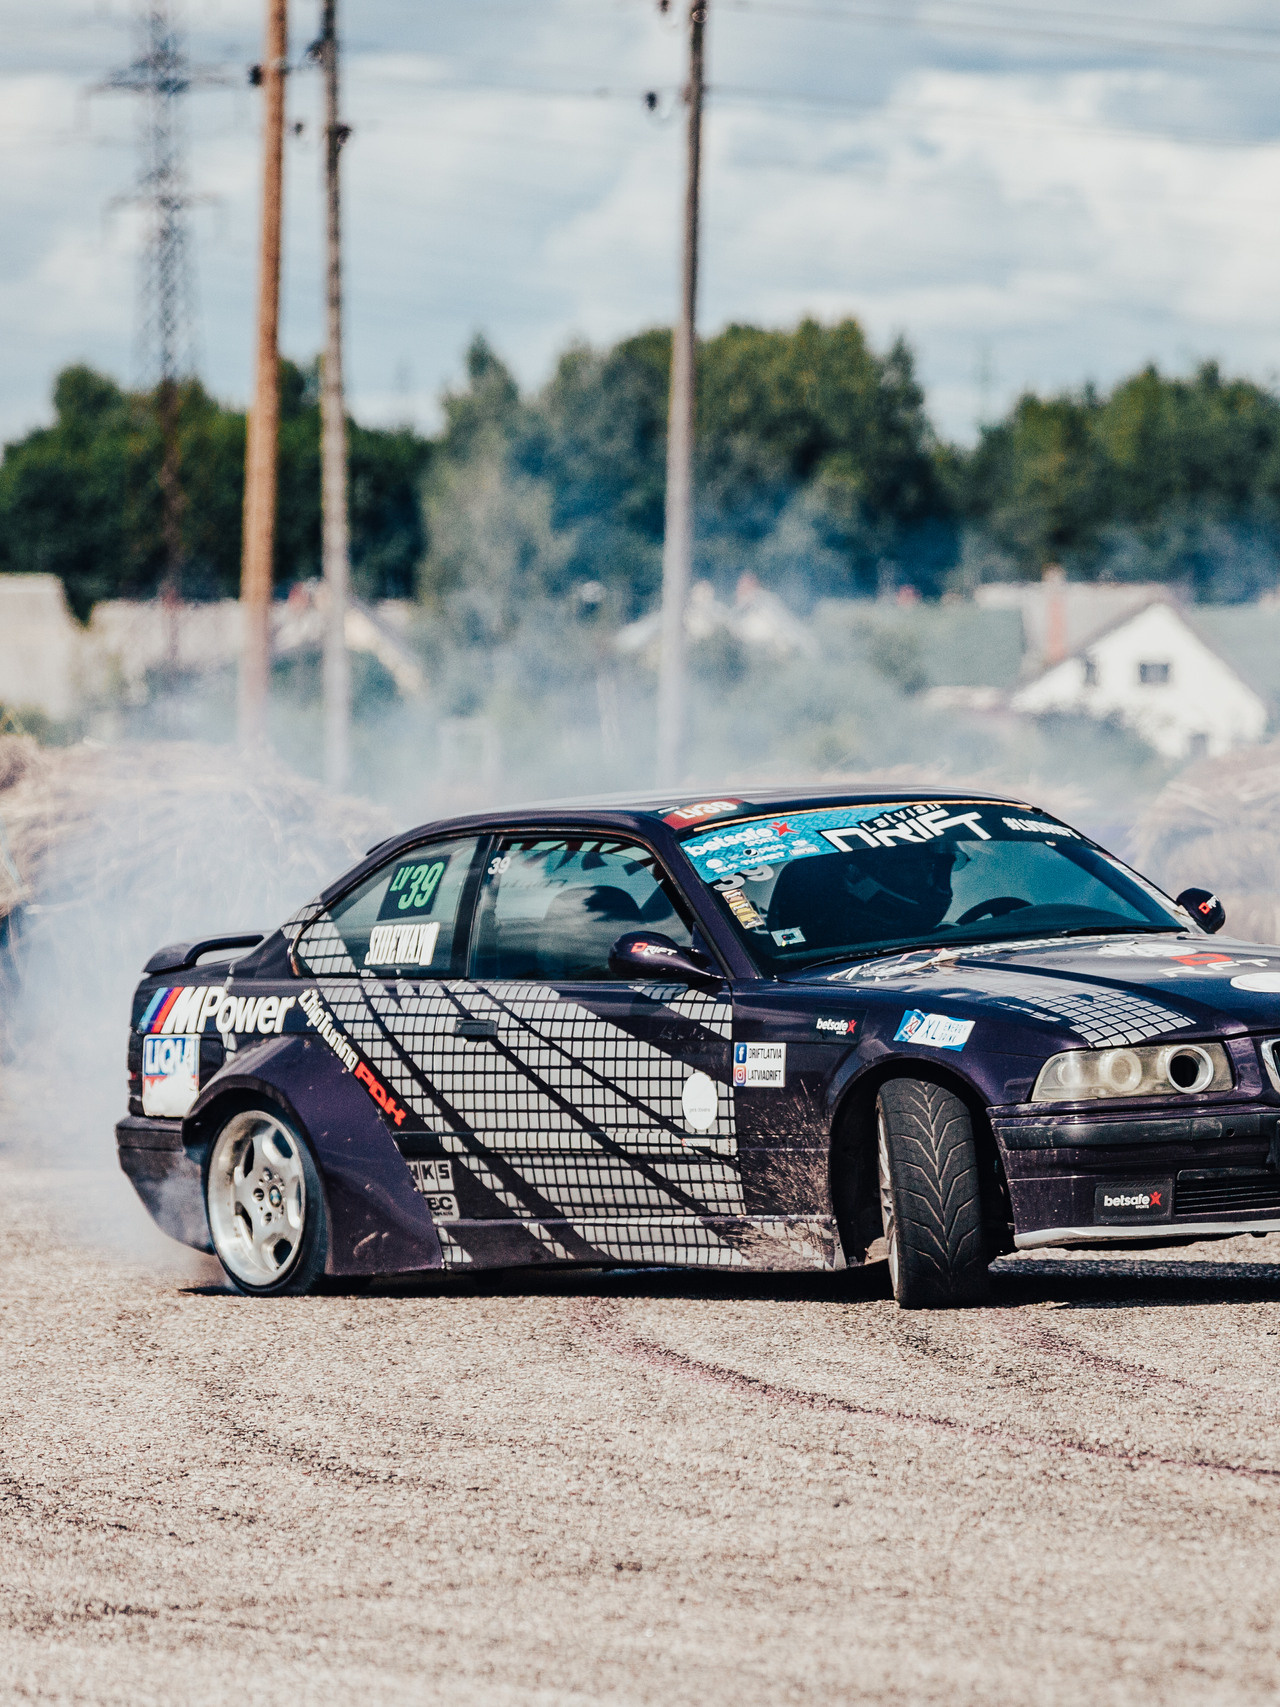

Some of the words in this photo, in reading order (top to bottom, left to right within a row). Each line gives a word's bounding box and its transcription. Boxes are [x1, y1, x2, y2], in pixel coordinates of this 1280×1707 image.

[860, 803, 941, 833] Latvian
[684, 827, 773, 857] betsafe
[487, 857, 511, 875] 39
[398, 862, 445, 910] 39
[631, 942, 677, 956] DRIFT
[816, 1018, 848, 1031] betsafe
[748, 1048, 782, 1059] DRIFTLATVIA
[747, 1070, 782, 1081] LATVIADRIFT
[1104, 1194, 1150, 1207] betsafe
